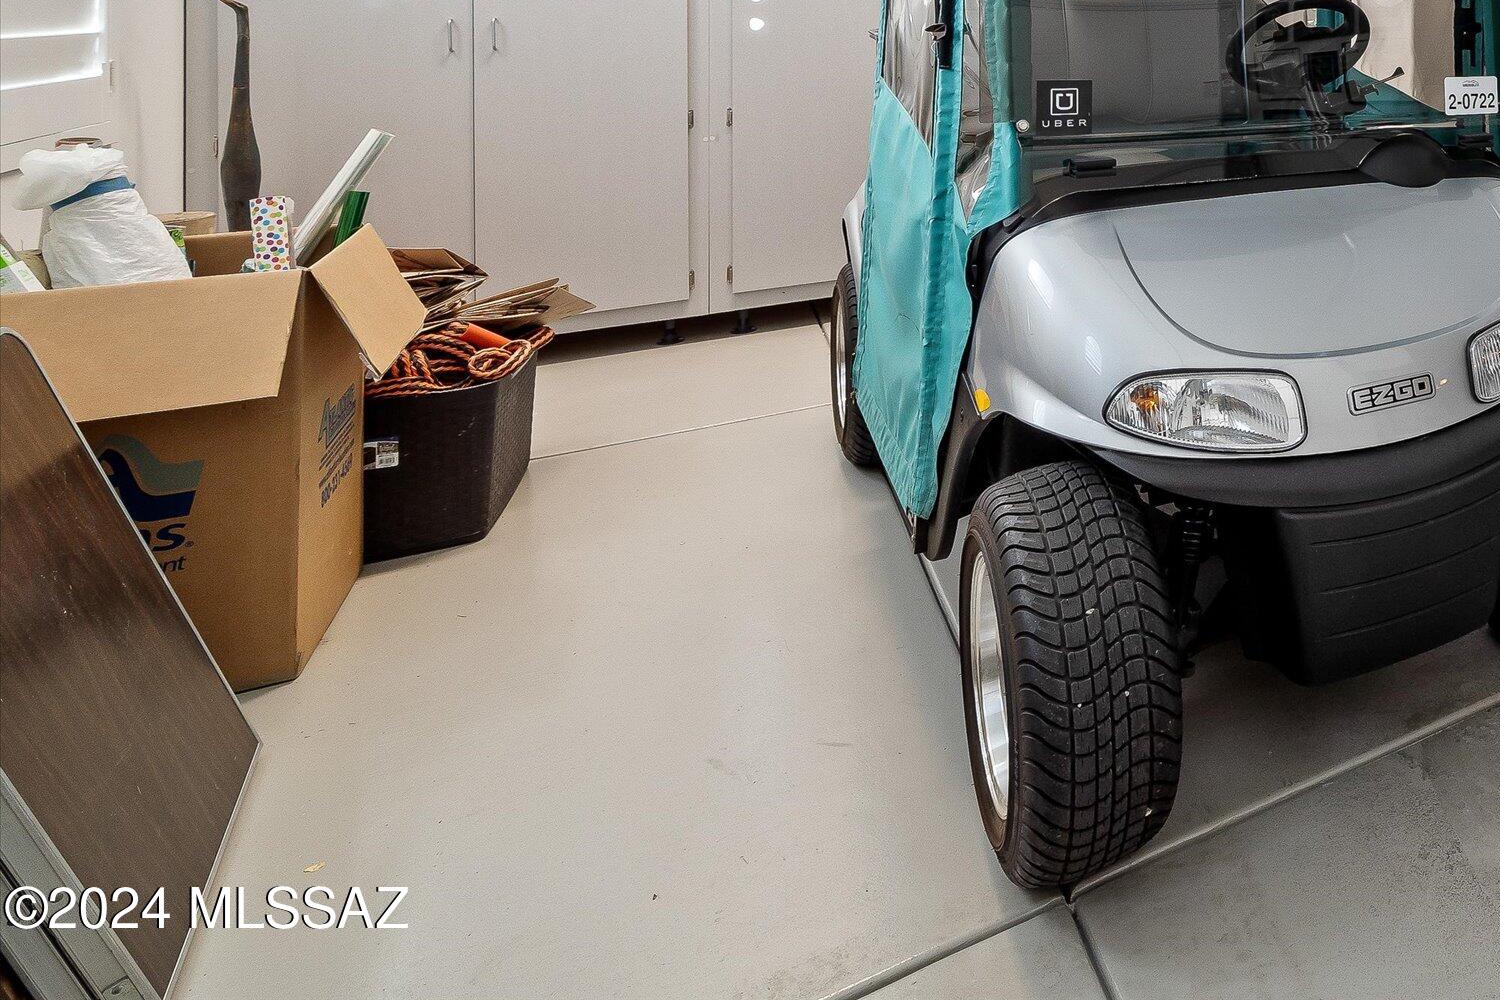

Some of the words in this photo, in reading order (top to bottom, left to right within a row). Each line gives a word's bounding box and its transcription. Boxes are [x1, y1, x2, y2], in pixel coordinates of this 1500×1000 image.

[1448, 92, 1496, 110] 2-0722
[1041, 118, 1087, 128] UBER
[1353, 375, 1432, 410] EZGO
